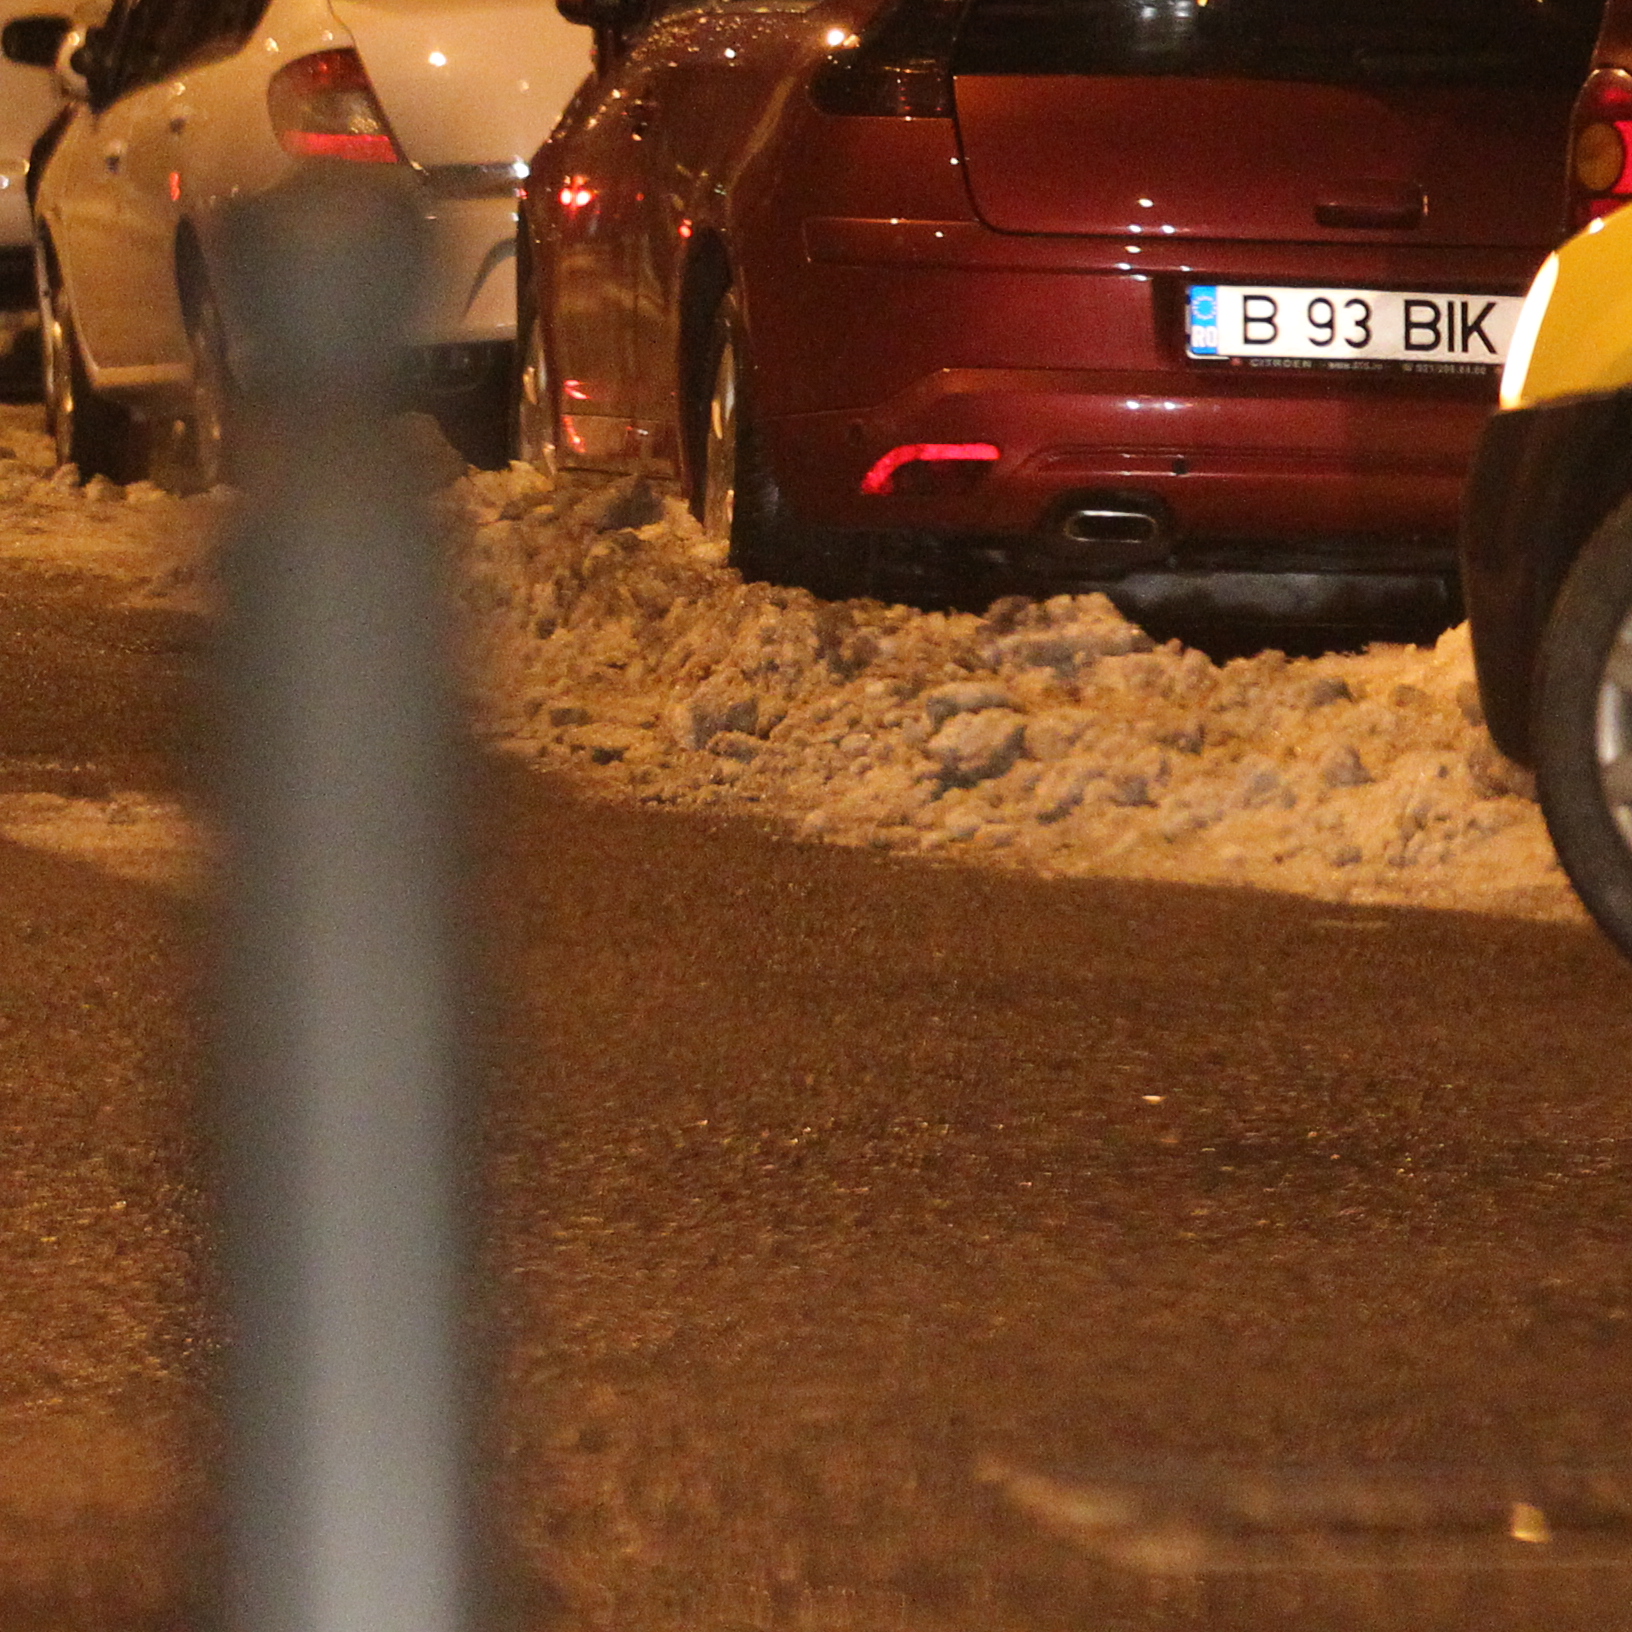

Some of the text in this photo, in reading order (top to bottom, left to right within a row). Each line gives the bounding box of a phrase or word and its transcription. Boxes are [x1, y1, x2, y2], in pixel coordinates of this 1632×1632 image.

[1243, 295, 1497, 354] B 93 BIK
